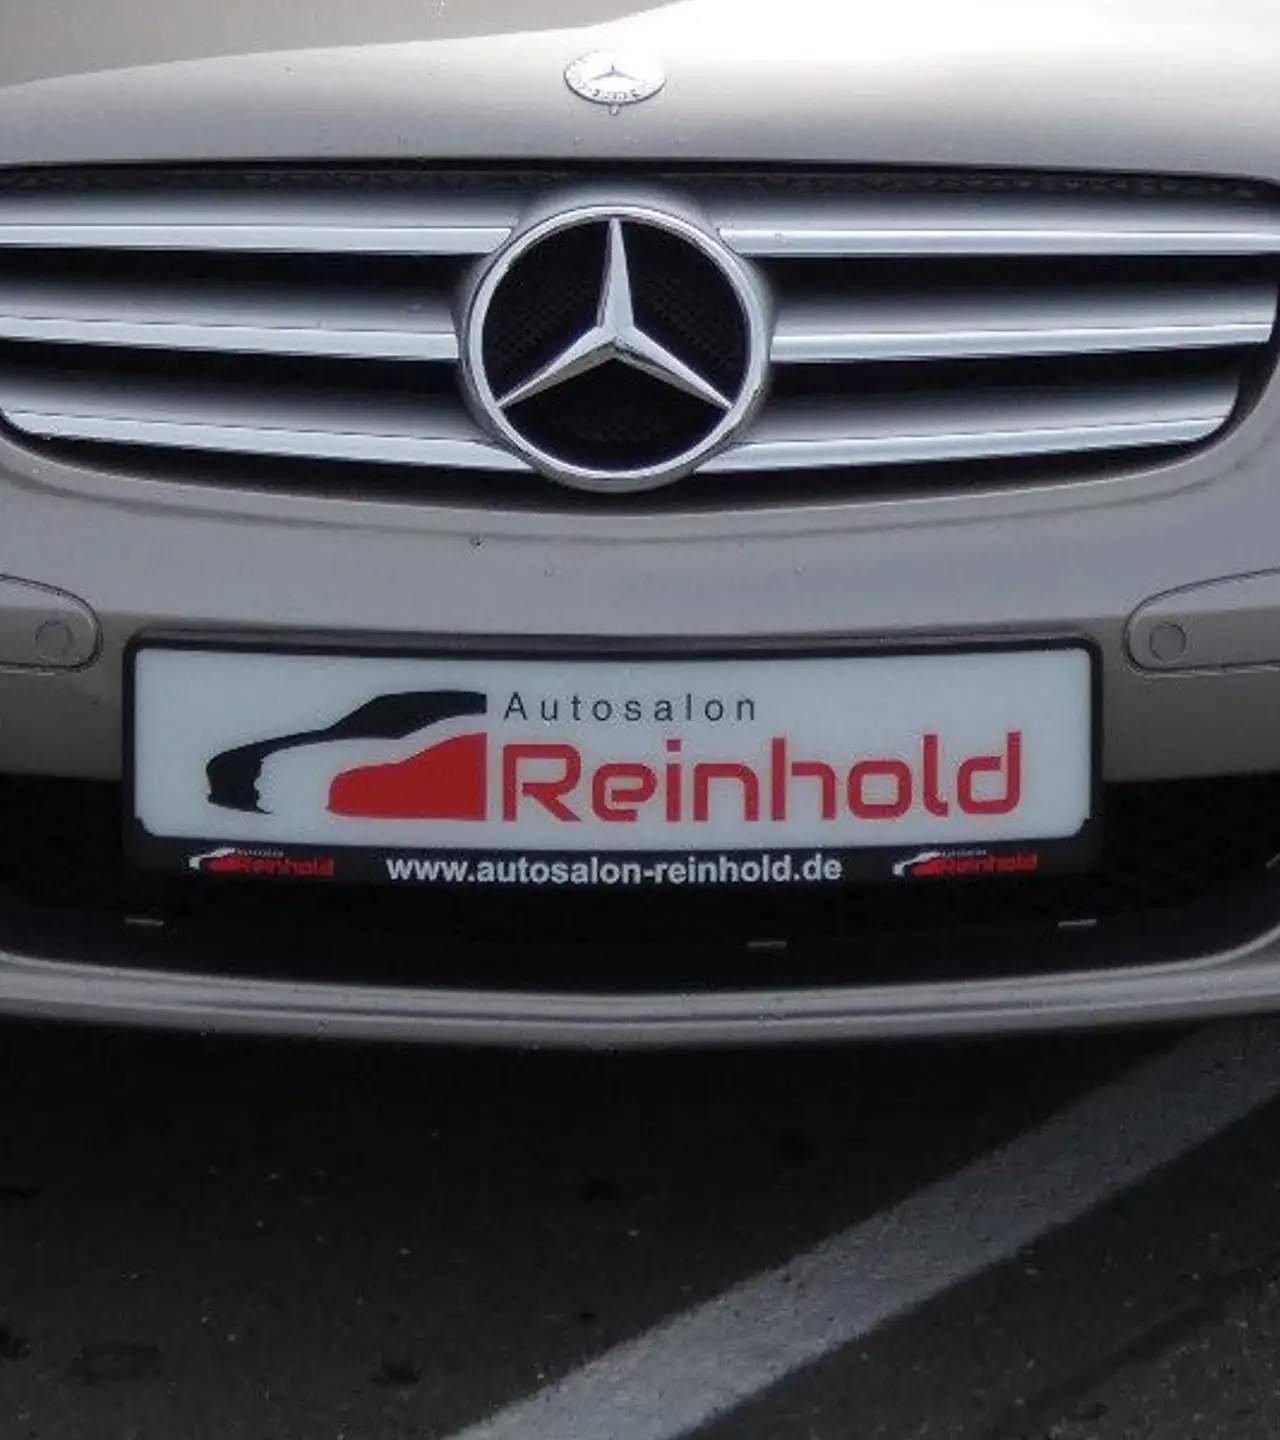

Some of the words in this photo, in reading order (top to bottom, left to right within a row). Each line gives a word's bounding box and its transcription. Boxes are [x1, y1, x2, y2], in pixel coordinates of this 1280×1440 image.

[504, 691, 757, 723] Autosalon
[504, 729, 1023, 823] Reinhold
[386, 850, 843, 884] www.autosalon-reinhold.de
